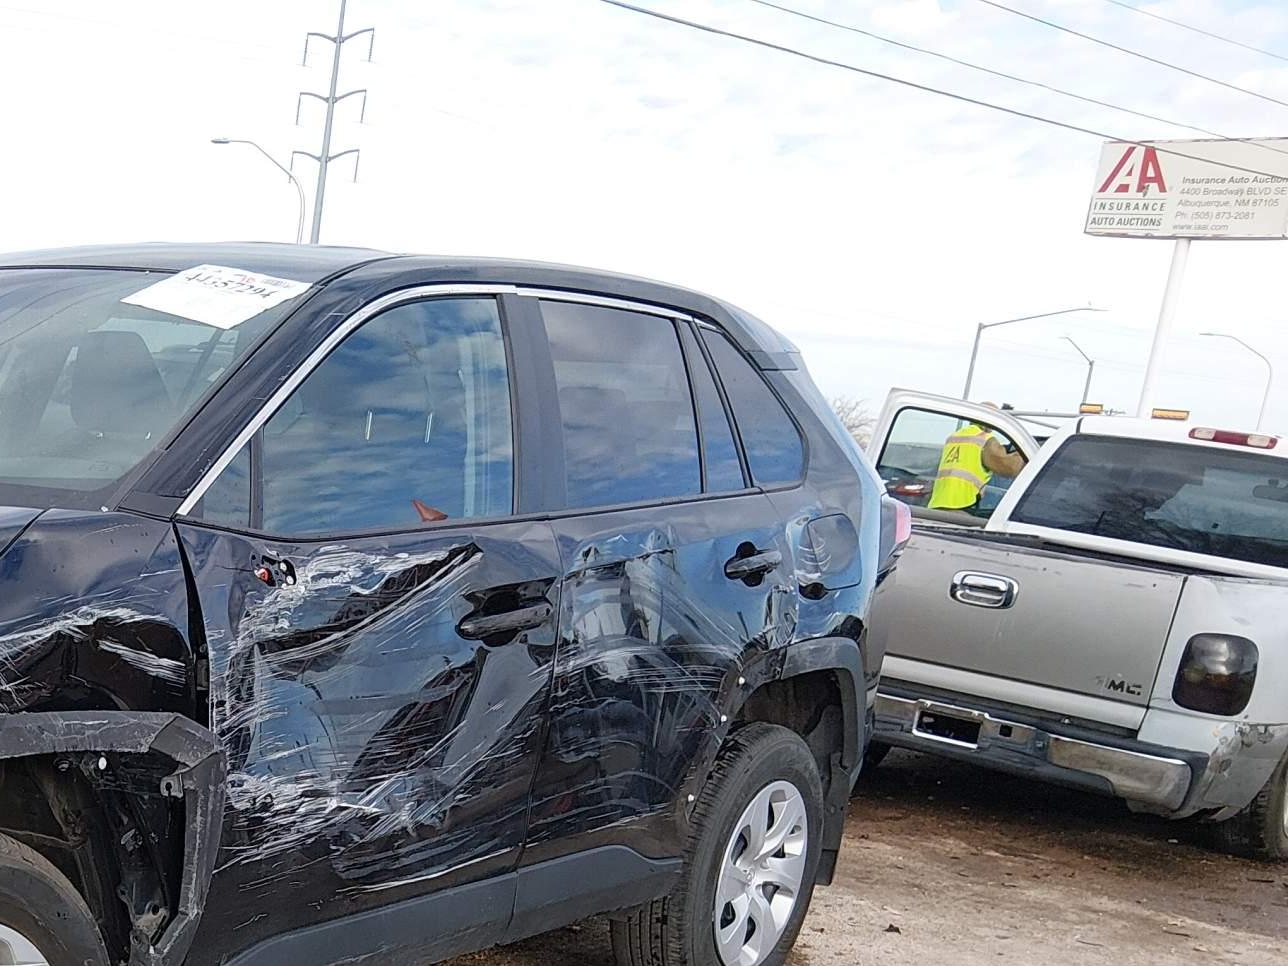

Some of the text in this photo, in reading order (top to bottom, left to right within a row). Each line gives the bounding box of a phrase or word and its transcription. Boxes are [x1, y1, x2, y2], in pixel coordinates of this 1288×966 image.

[1182, 176, 1226, 184] Insurance
[1228, 176, 1250, 184] Auto
[1180, 187, 1201, 196] 4400
[1202, 187, 1244, 197] Broadway
[1246, 187, 1272, 195] BLVD
[1093, 202, 1166, 212] INSURANCE
[1233, 199, 1250, 207] NM
[1090, 216, 1162, 227] AUTO AUCTIONS
